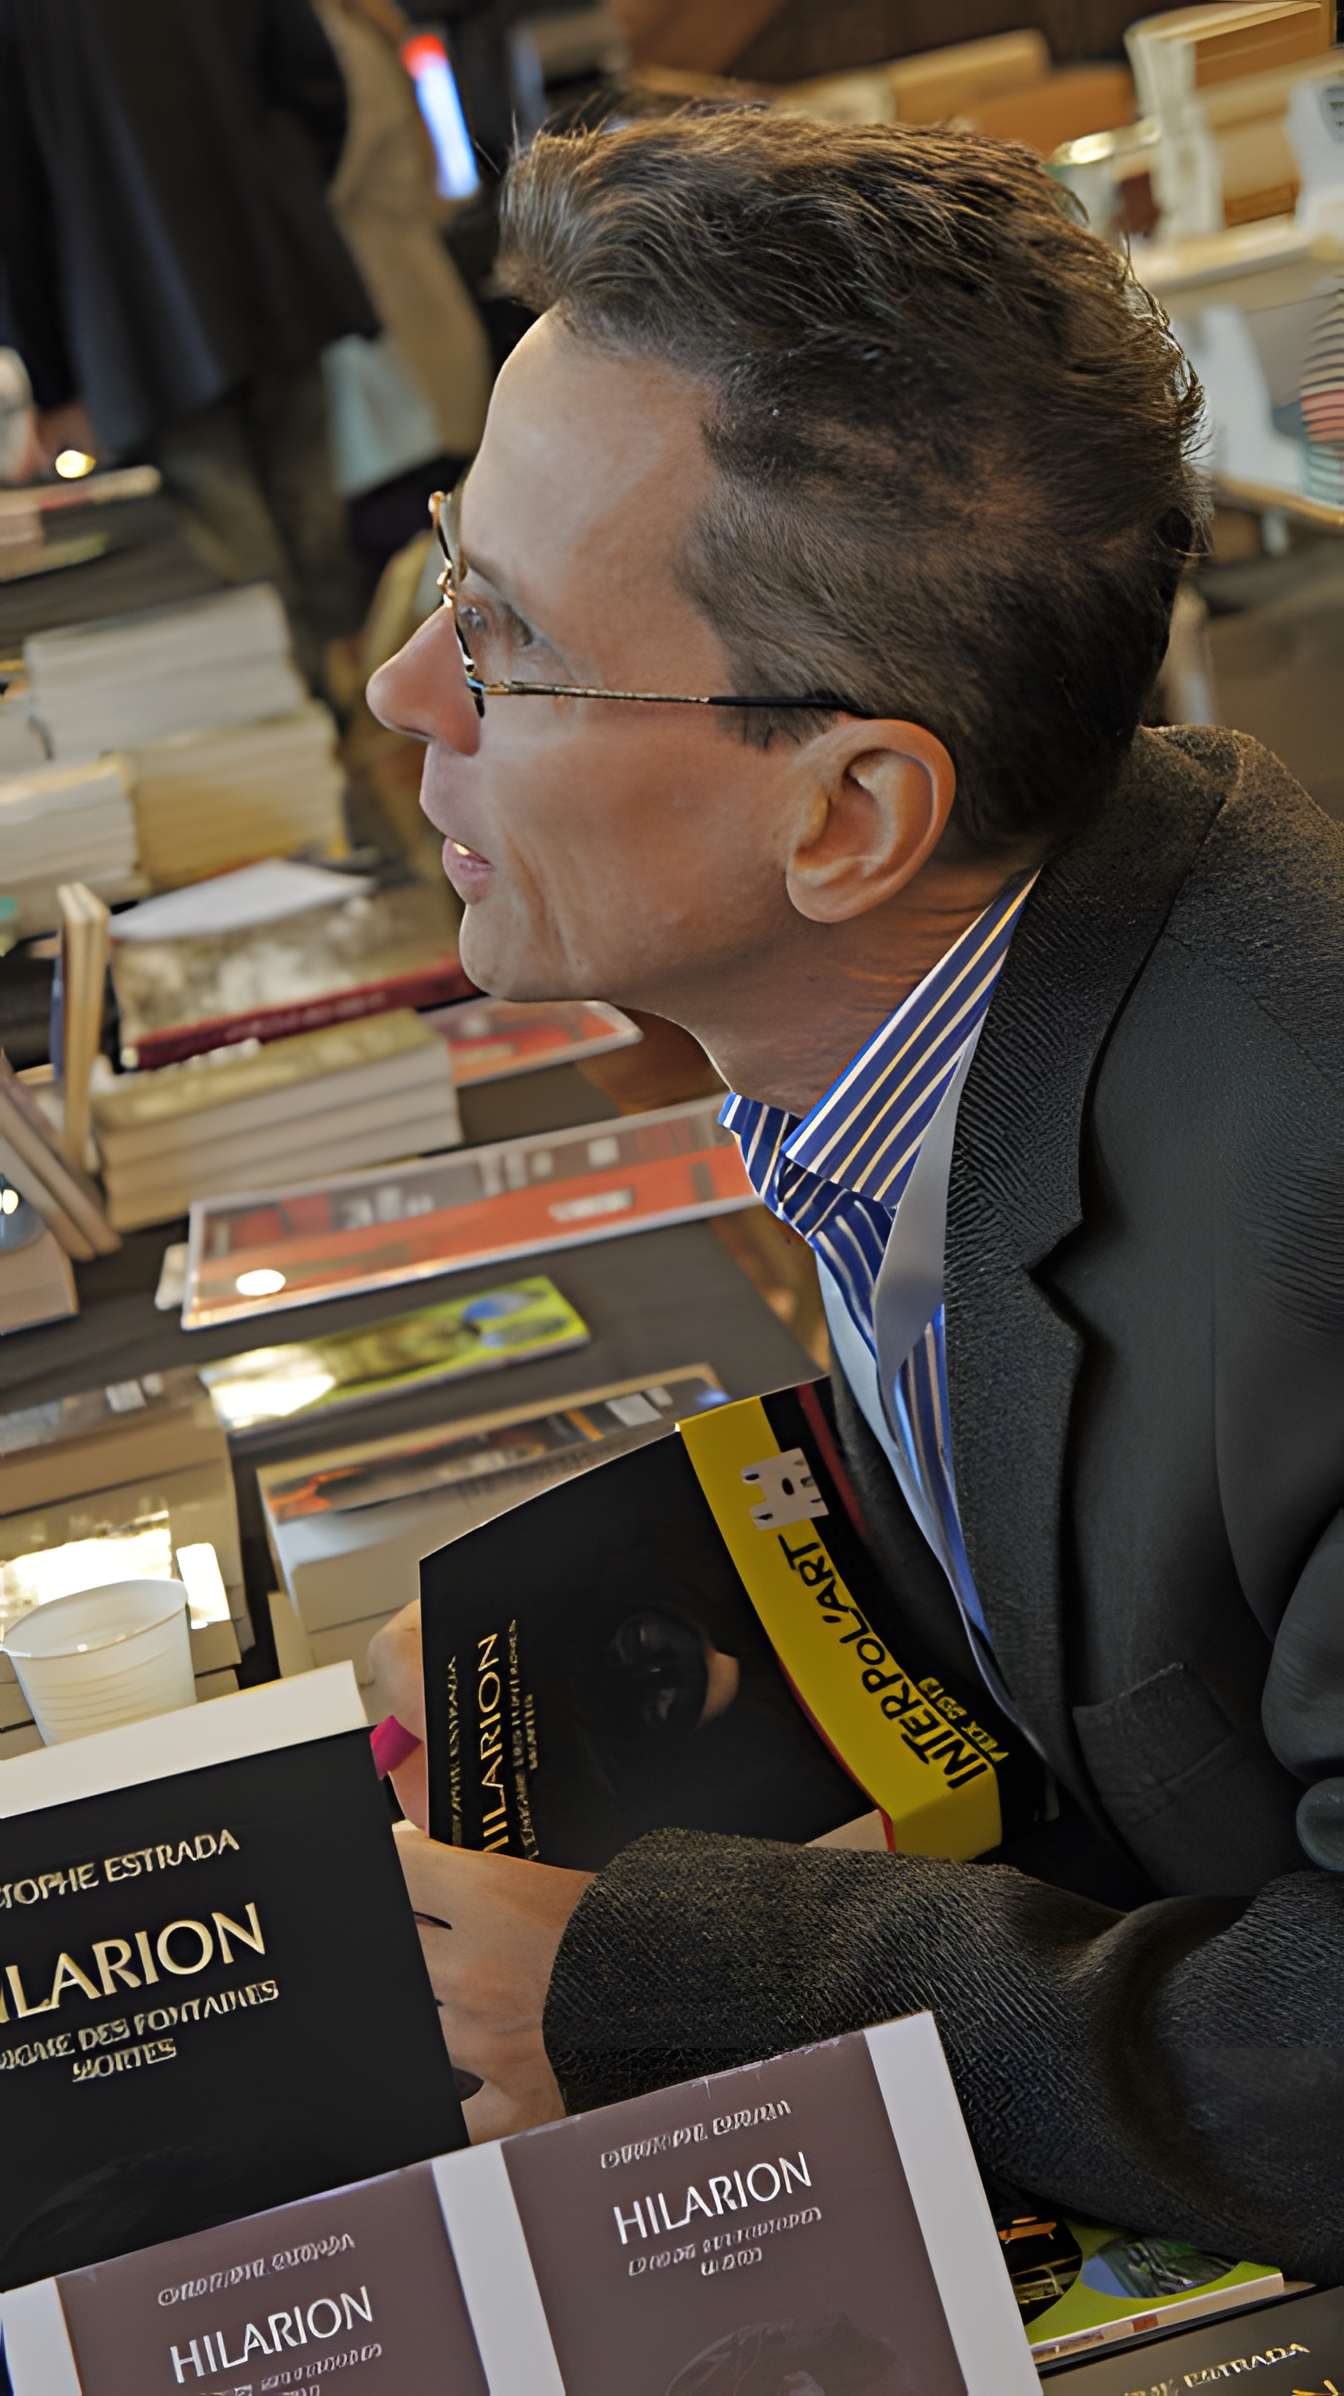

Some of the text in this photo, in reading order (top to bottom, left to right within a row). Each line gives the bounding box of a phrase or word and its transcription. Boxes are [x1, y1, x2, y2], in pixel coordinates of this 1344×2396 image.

[778, 1533, 988, 1789] INTERPOL'ART
[104, 1828, 240, 1883] ESTRADA
[612, 2151, 812, 2245] HILARION
[169, 2285, 373, 2384] HILARION
